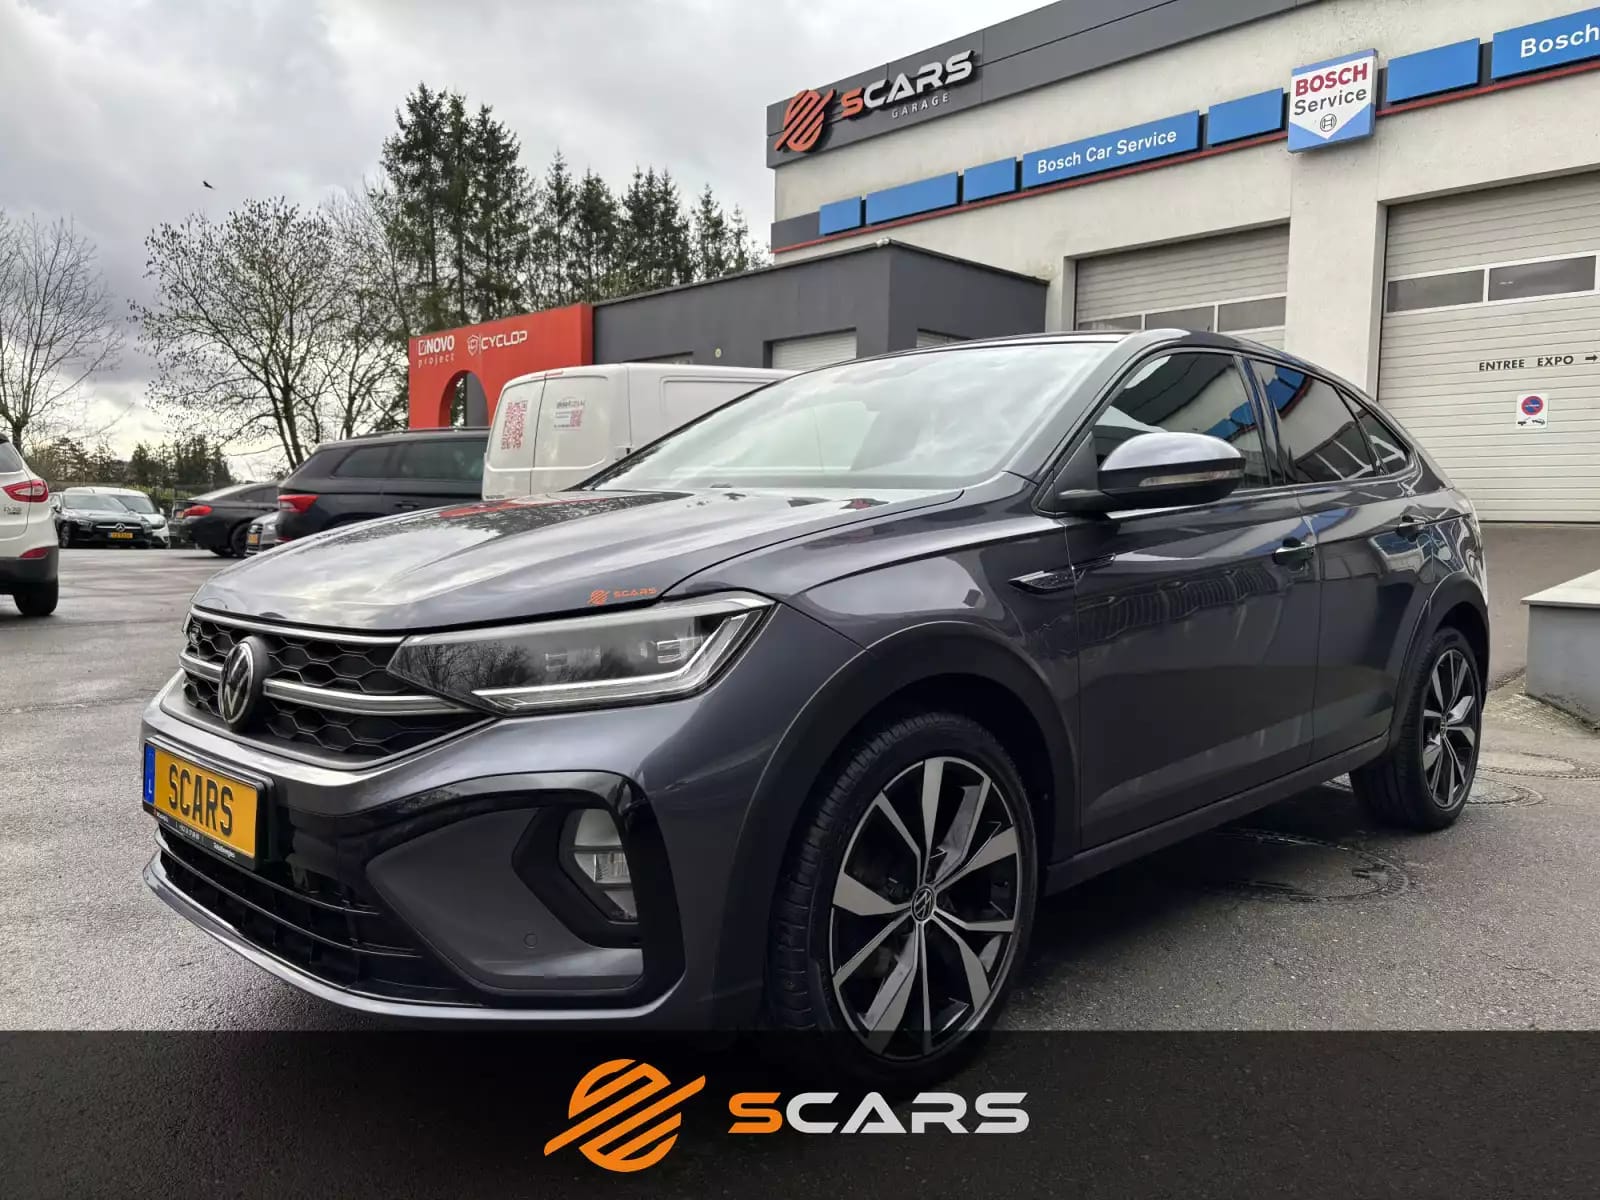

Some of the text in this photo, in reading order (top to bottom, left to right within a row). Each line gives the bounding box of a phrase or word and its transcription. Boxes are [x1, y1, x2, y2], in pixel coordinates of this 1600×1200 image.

[1520, 23, 1600, 58] Bosch
[841, 50, 973, 119] SCARS
[1295, 62, 1368, 97] BOSCH
[892, 92, 950, 119] GARAGE
[1294, 88, 1367, 116] Service
[1037, 130, 1177, 174] Bosch Car Service
[418, 352, 455, 368] project
[1479, 355, 1574, 372] ENTREE EXPO
[168, 763, 235, 838] SCARS
